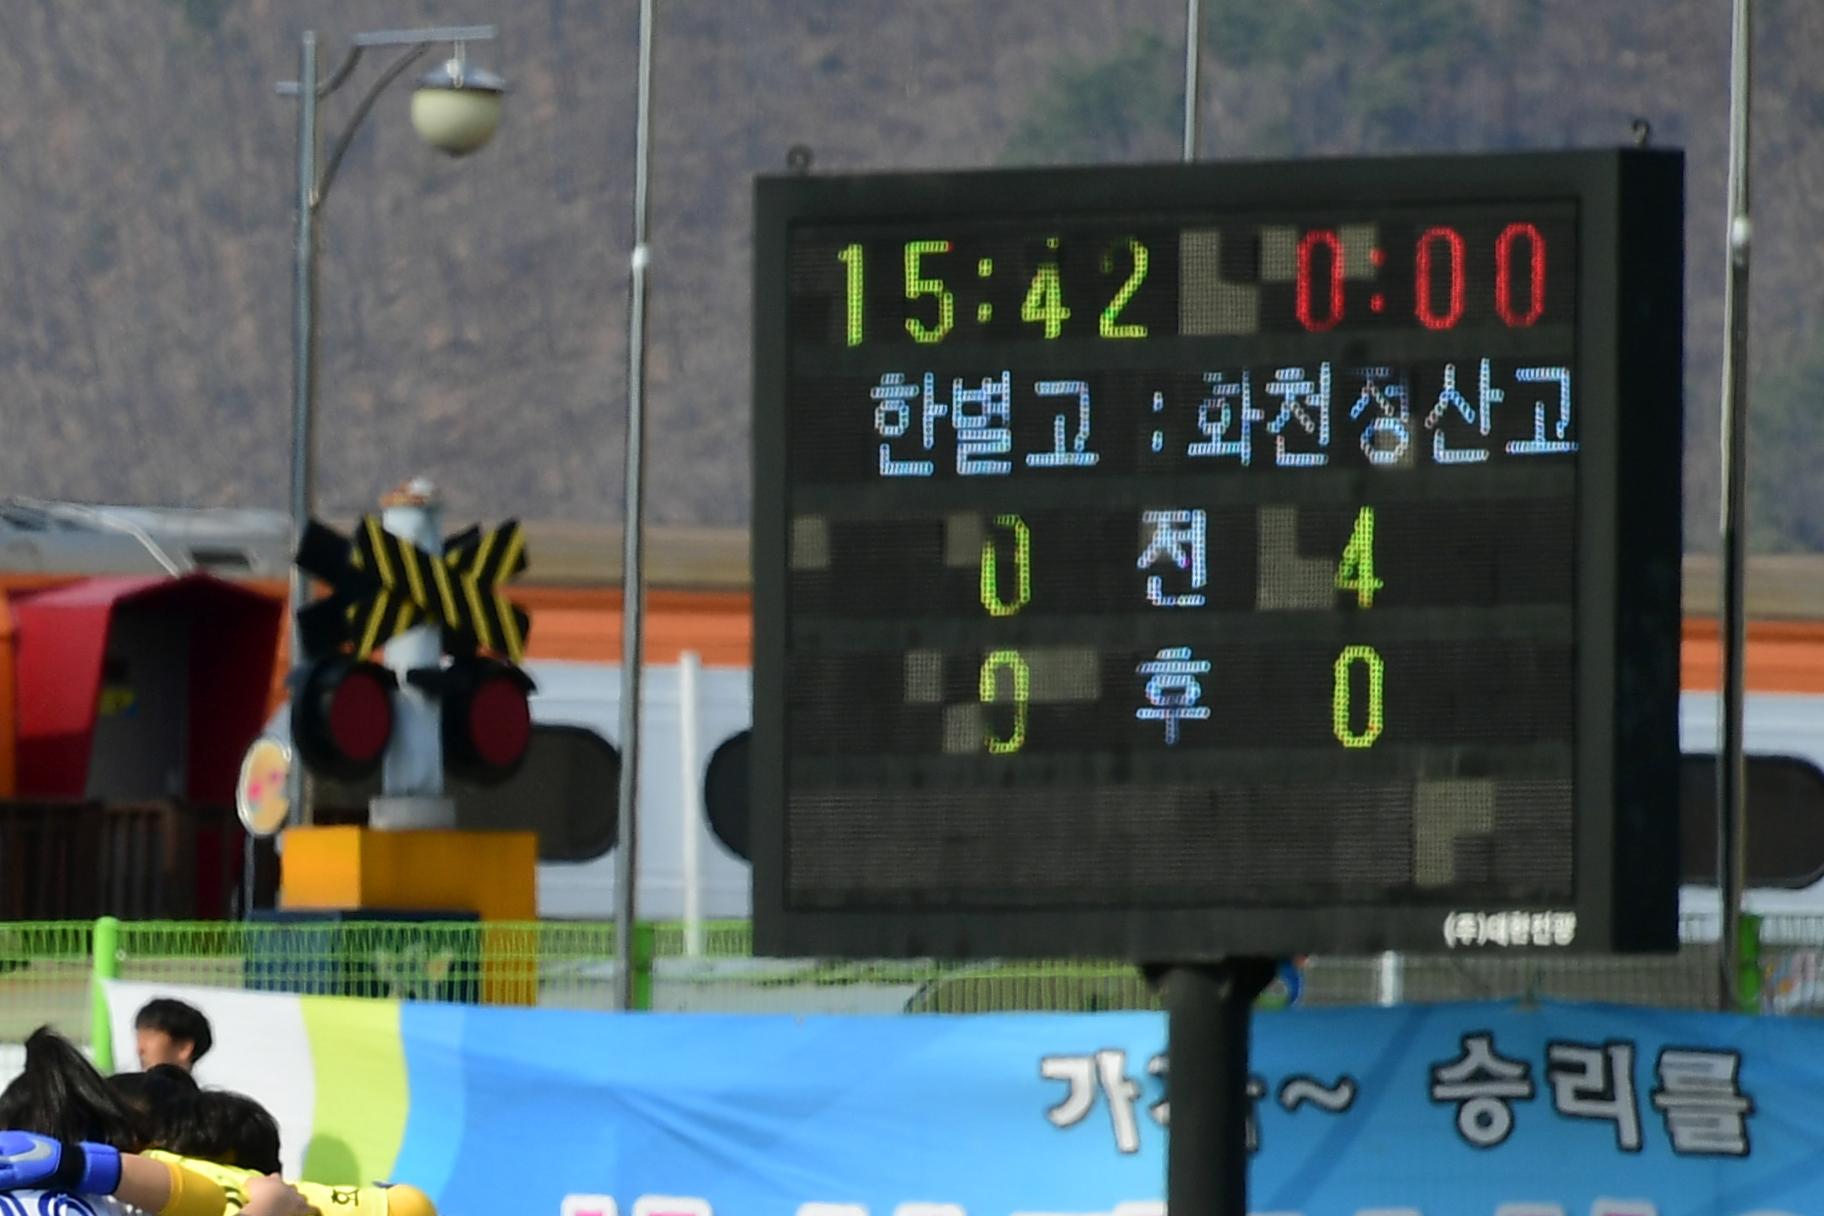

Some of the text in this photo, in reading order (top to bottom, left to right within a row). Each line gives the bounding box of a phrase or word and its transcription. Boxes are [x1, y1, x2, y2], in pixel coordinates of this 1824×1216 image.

[836, 221, 1547, 348] 15:42 0:00
[869, 370, 1101, 477] 한별고
[1135, 508, 1209, 608] 전
[1333, 505, 1384, 609] 4
[1135, 644, 1211, 744] 후
[1332, 643, 1385, 749] 0
[1429, 1031, 1753, 1157] 승리를
